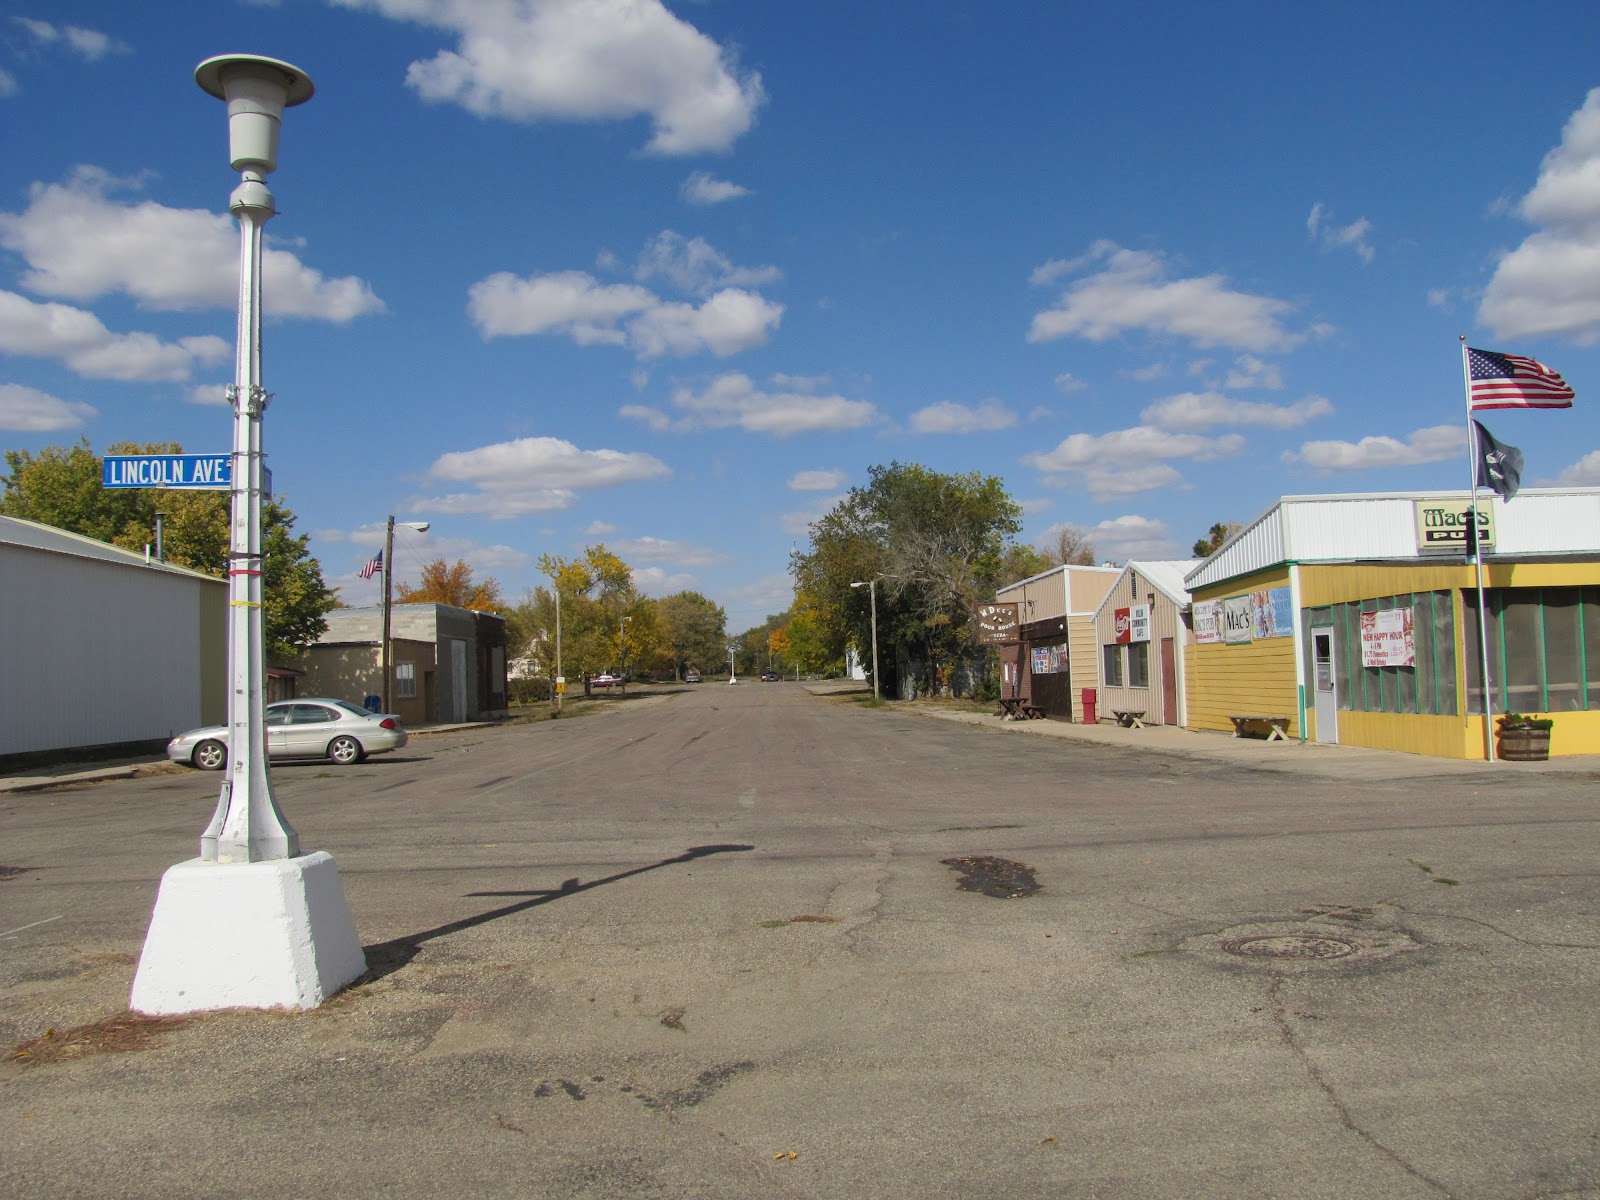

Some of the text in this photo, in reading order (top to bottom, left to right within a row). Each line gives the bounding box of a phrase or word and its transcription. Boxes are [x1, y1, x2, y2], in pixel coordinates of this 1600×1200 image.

[111, 458, 224, 484] LINCOLN AVE
[1423, 508, 1489, 526] Macs
[1374, 632, 1389, 641] HAPPY
[1389, 631, 1403, 640] HOUR
